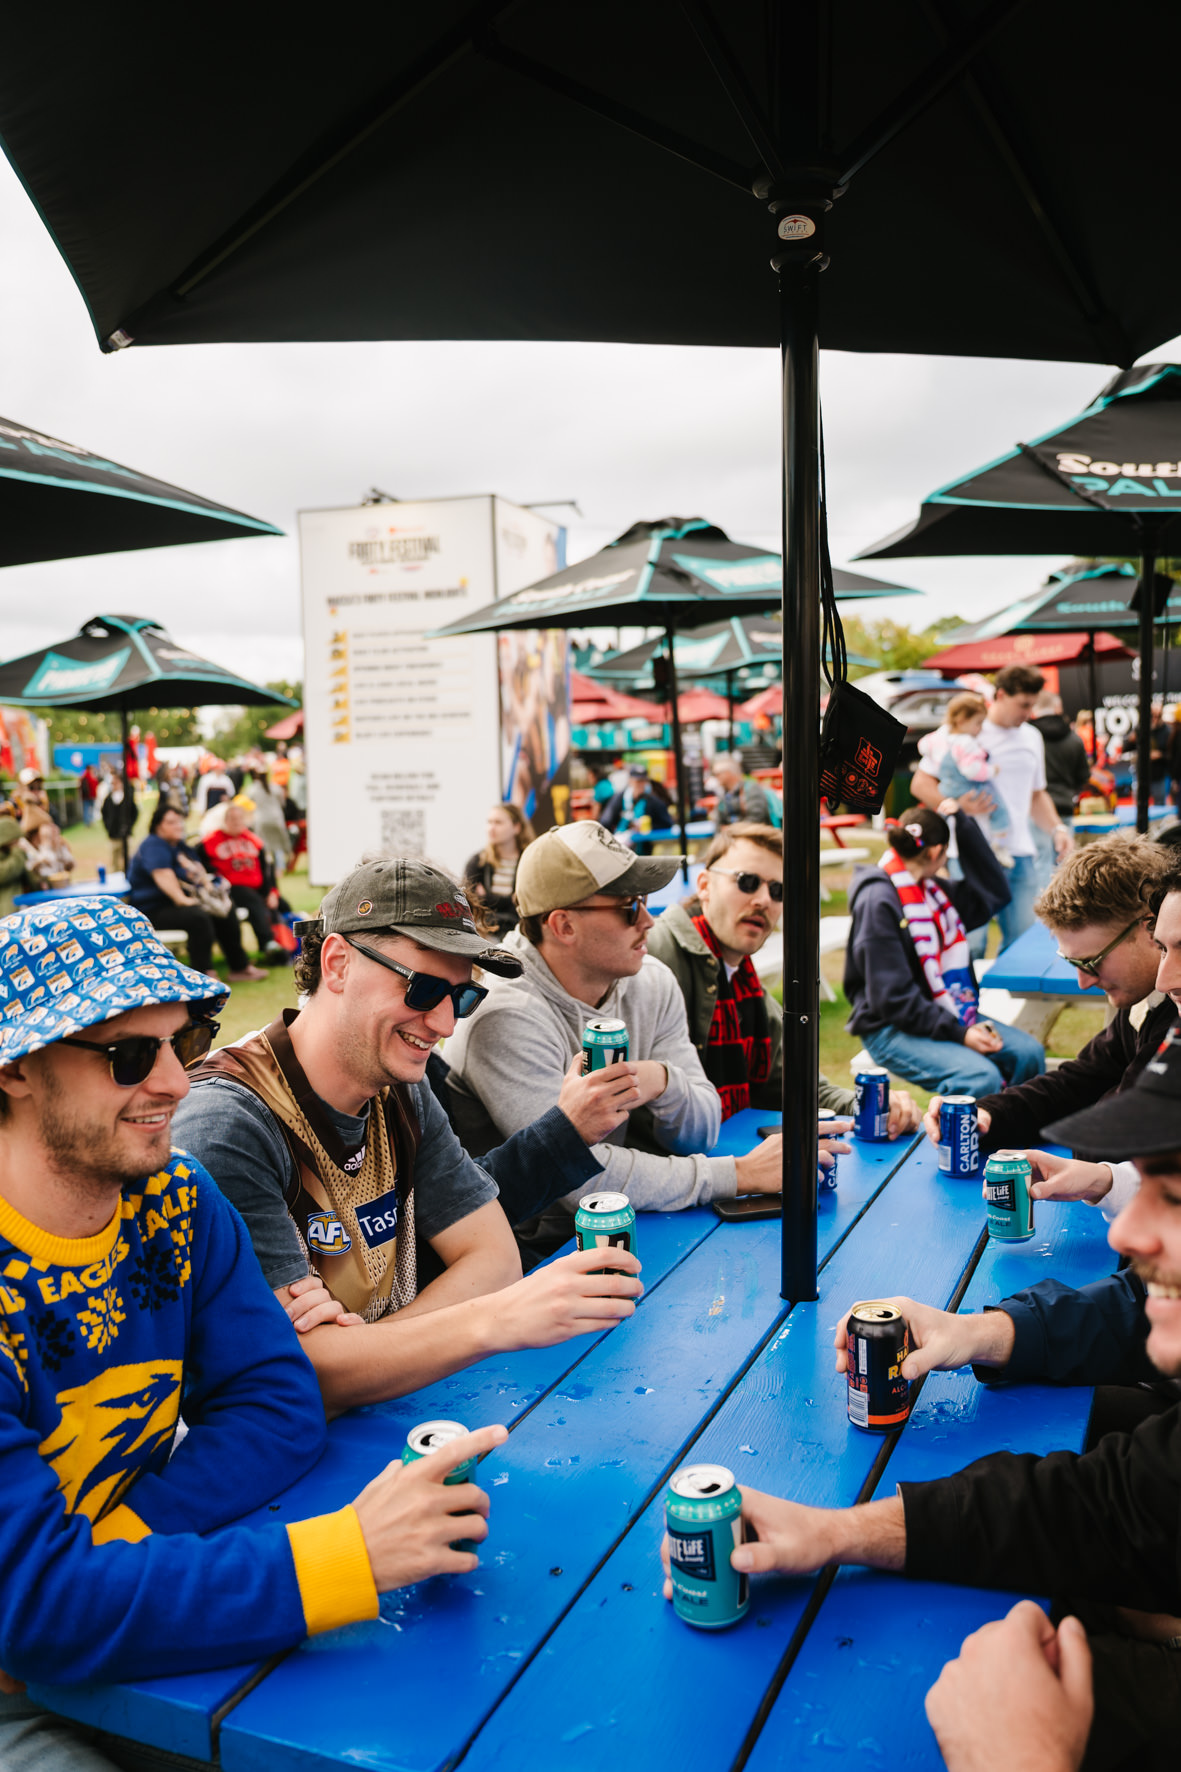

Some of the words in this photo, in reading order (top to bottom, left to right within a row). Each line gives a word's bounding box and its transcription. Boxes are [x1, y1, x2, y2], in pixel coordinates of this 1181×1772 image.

[784, 225, 807, 233] SWIFT
[1056, 453, 1181, 478] Sout
[960, 1114, 970, 1173] CARLTON
[37, 1236, 130, 1305] EAGLES
